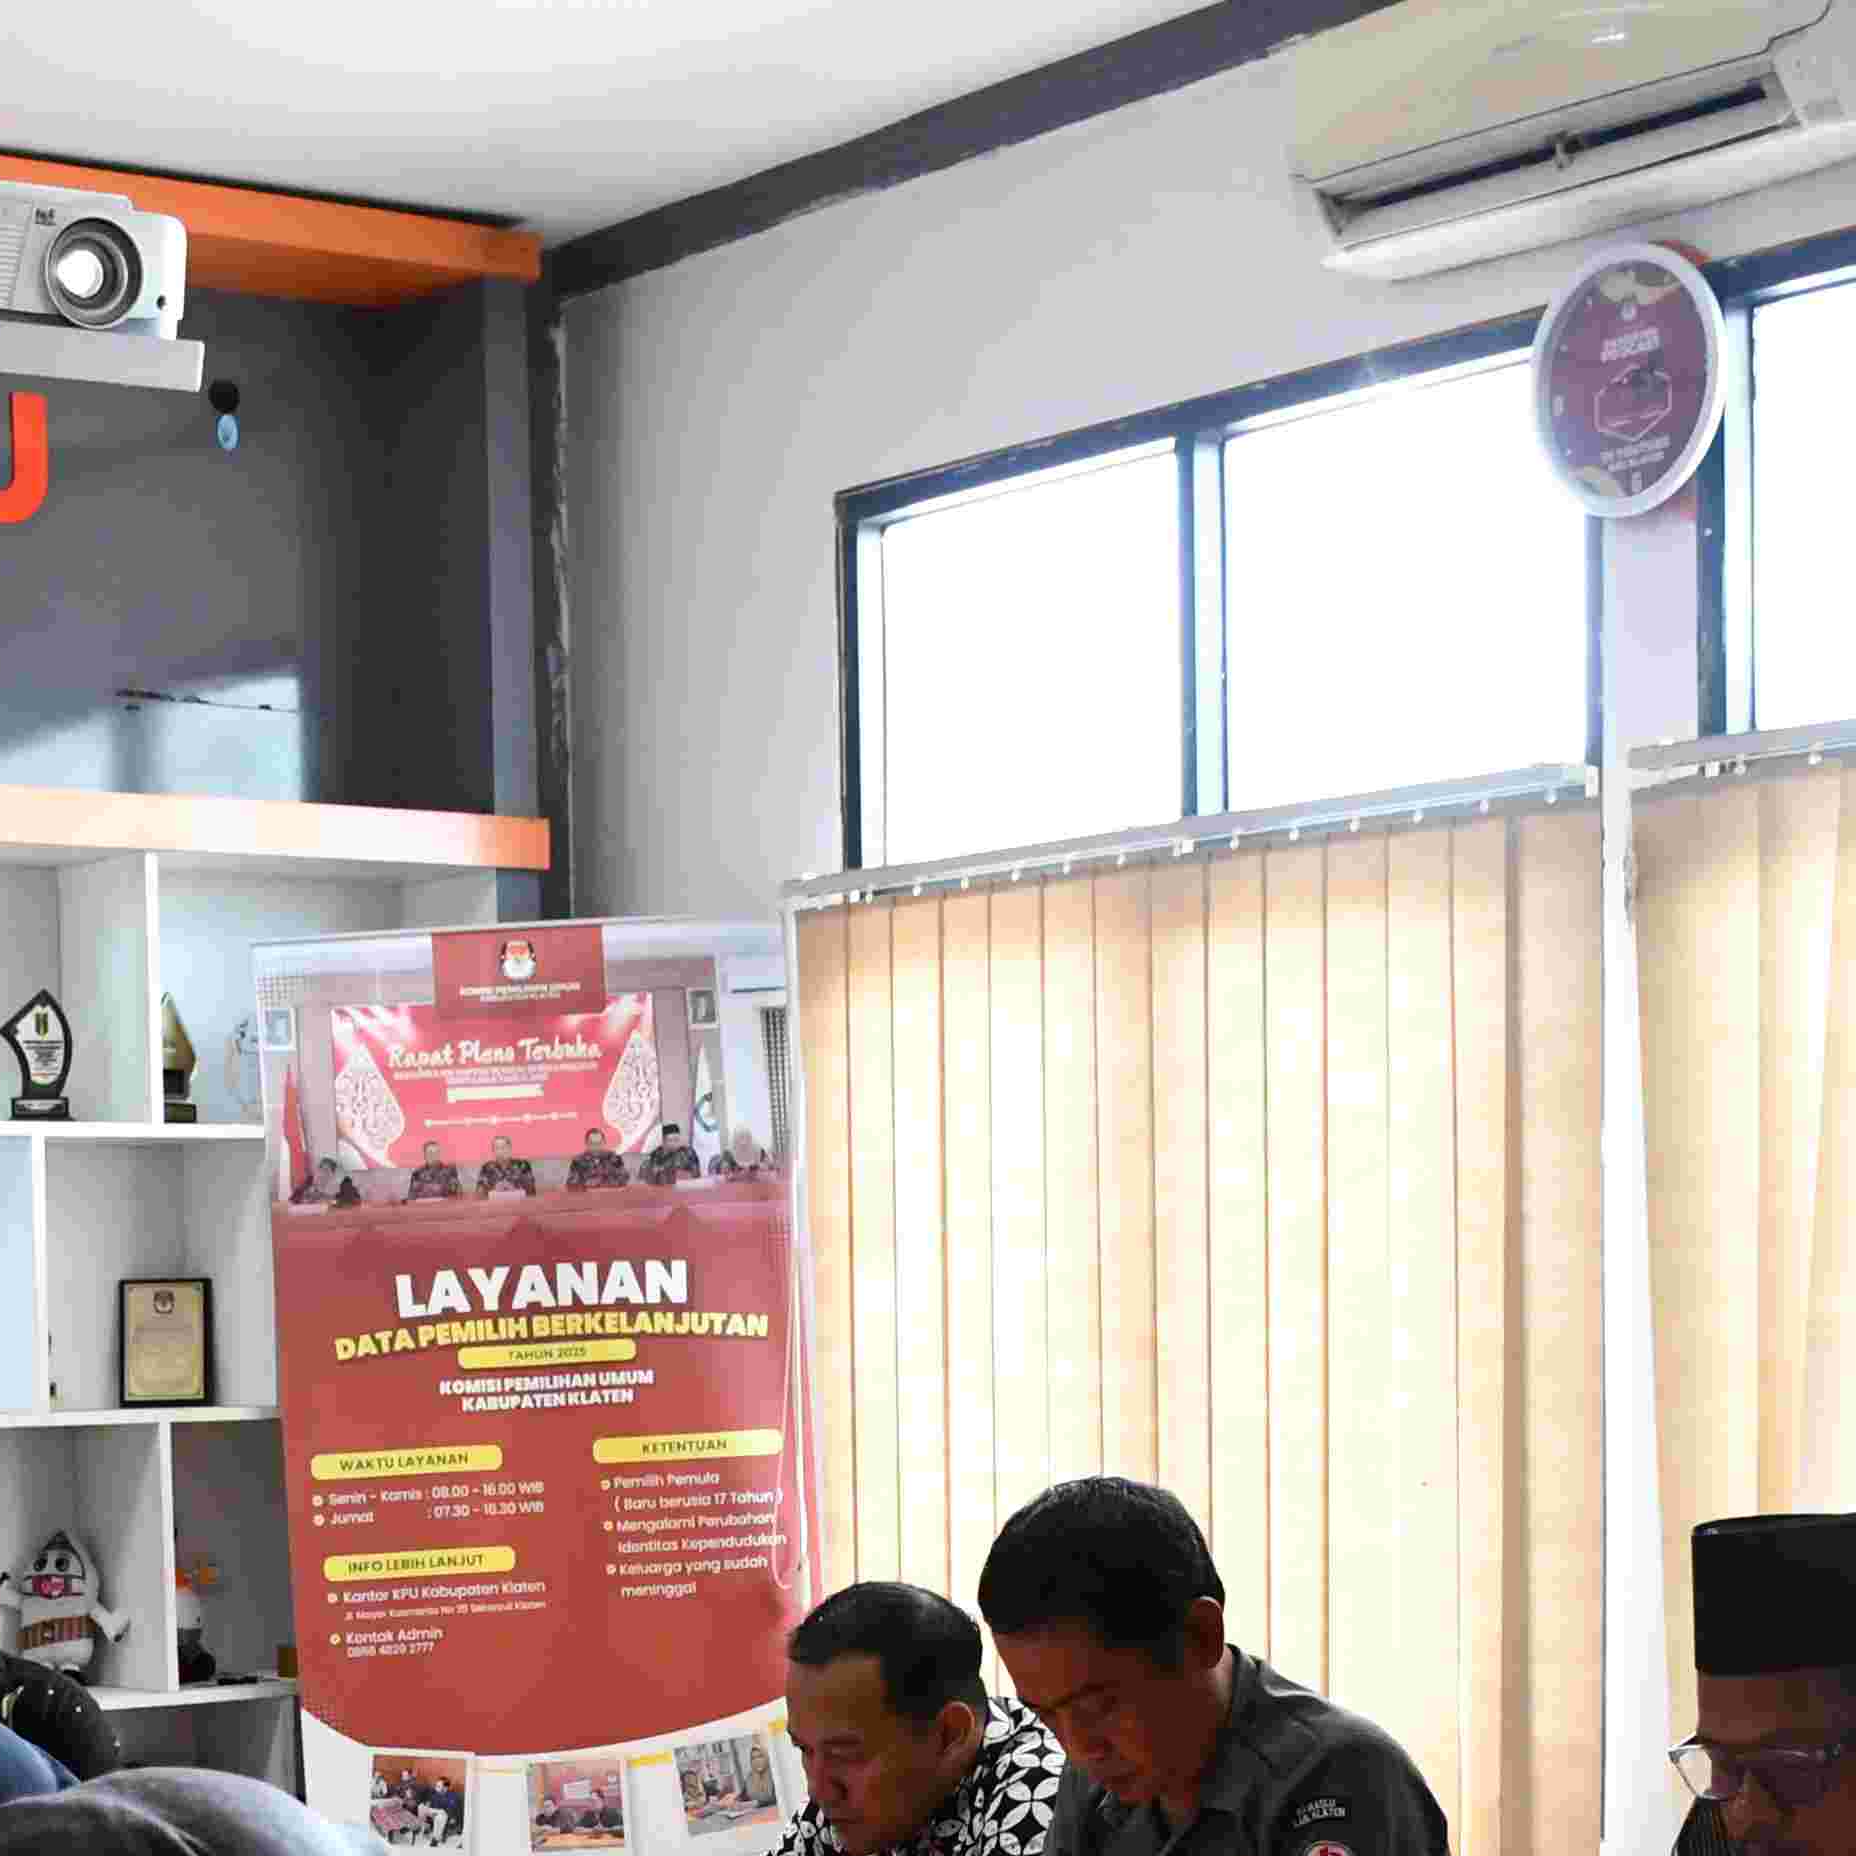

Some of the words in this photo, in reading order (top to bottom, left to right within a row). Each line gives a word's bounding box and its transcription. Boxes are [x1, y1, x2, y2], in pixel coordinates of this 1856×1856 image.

[395, 1260, 688, 1318] LAYANAN
[335, 1328, 416, 1361] DATA
[417, 1316, 528, 1348] PEMILIH
[532, 1311, 769, 1338] BERKELANJUTAN
[508, 1349, 553, 1361] TAHUN
[440, 1378, 502, 1395] KOMISI
[504, 1371, 596, 1392] PEMILIHAN
[599, 1369, 654, 1387] UMUM
[462, 1392, 568, 1412] KABUPATEN
[569, 1389, 634, 1407] KLATEN
[642, 1439, 727, 1455] KETENTUAN
[340, 1457, 394, 1471] WAKTU
[398, 1452, 469, 1468] LAYANAN
[328, 1492, 366, 1506] Senin
[624, 1497, 656, 1510] Baru
[659, 1493, 711, 1508] berusia
[347, 1559, 383, 1574] INFO
[386, 1557, 426, 1572] LEBIH
[429, 1554, 485, 1569] LANJUT
[684, 1558, 721, 1575] yang
[343, 1589, 389, 1603] Kantor
[392, 1588, 418, 1601] KPU
[421, 1583, 499, 1601] Kabupaten
[501, 1580, 546, 1594] Klaten
[346, 1631, 394, 1646] Kontak
[398, 1627, 443, 1642] Admin
